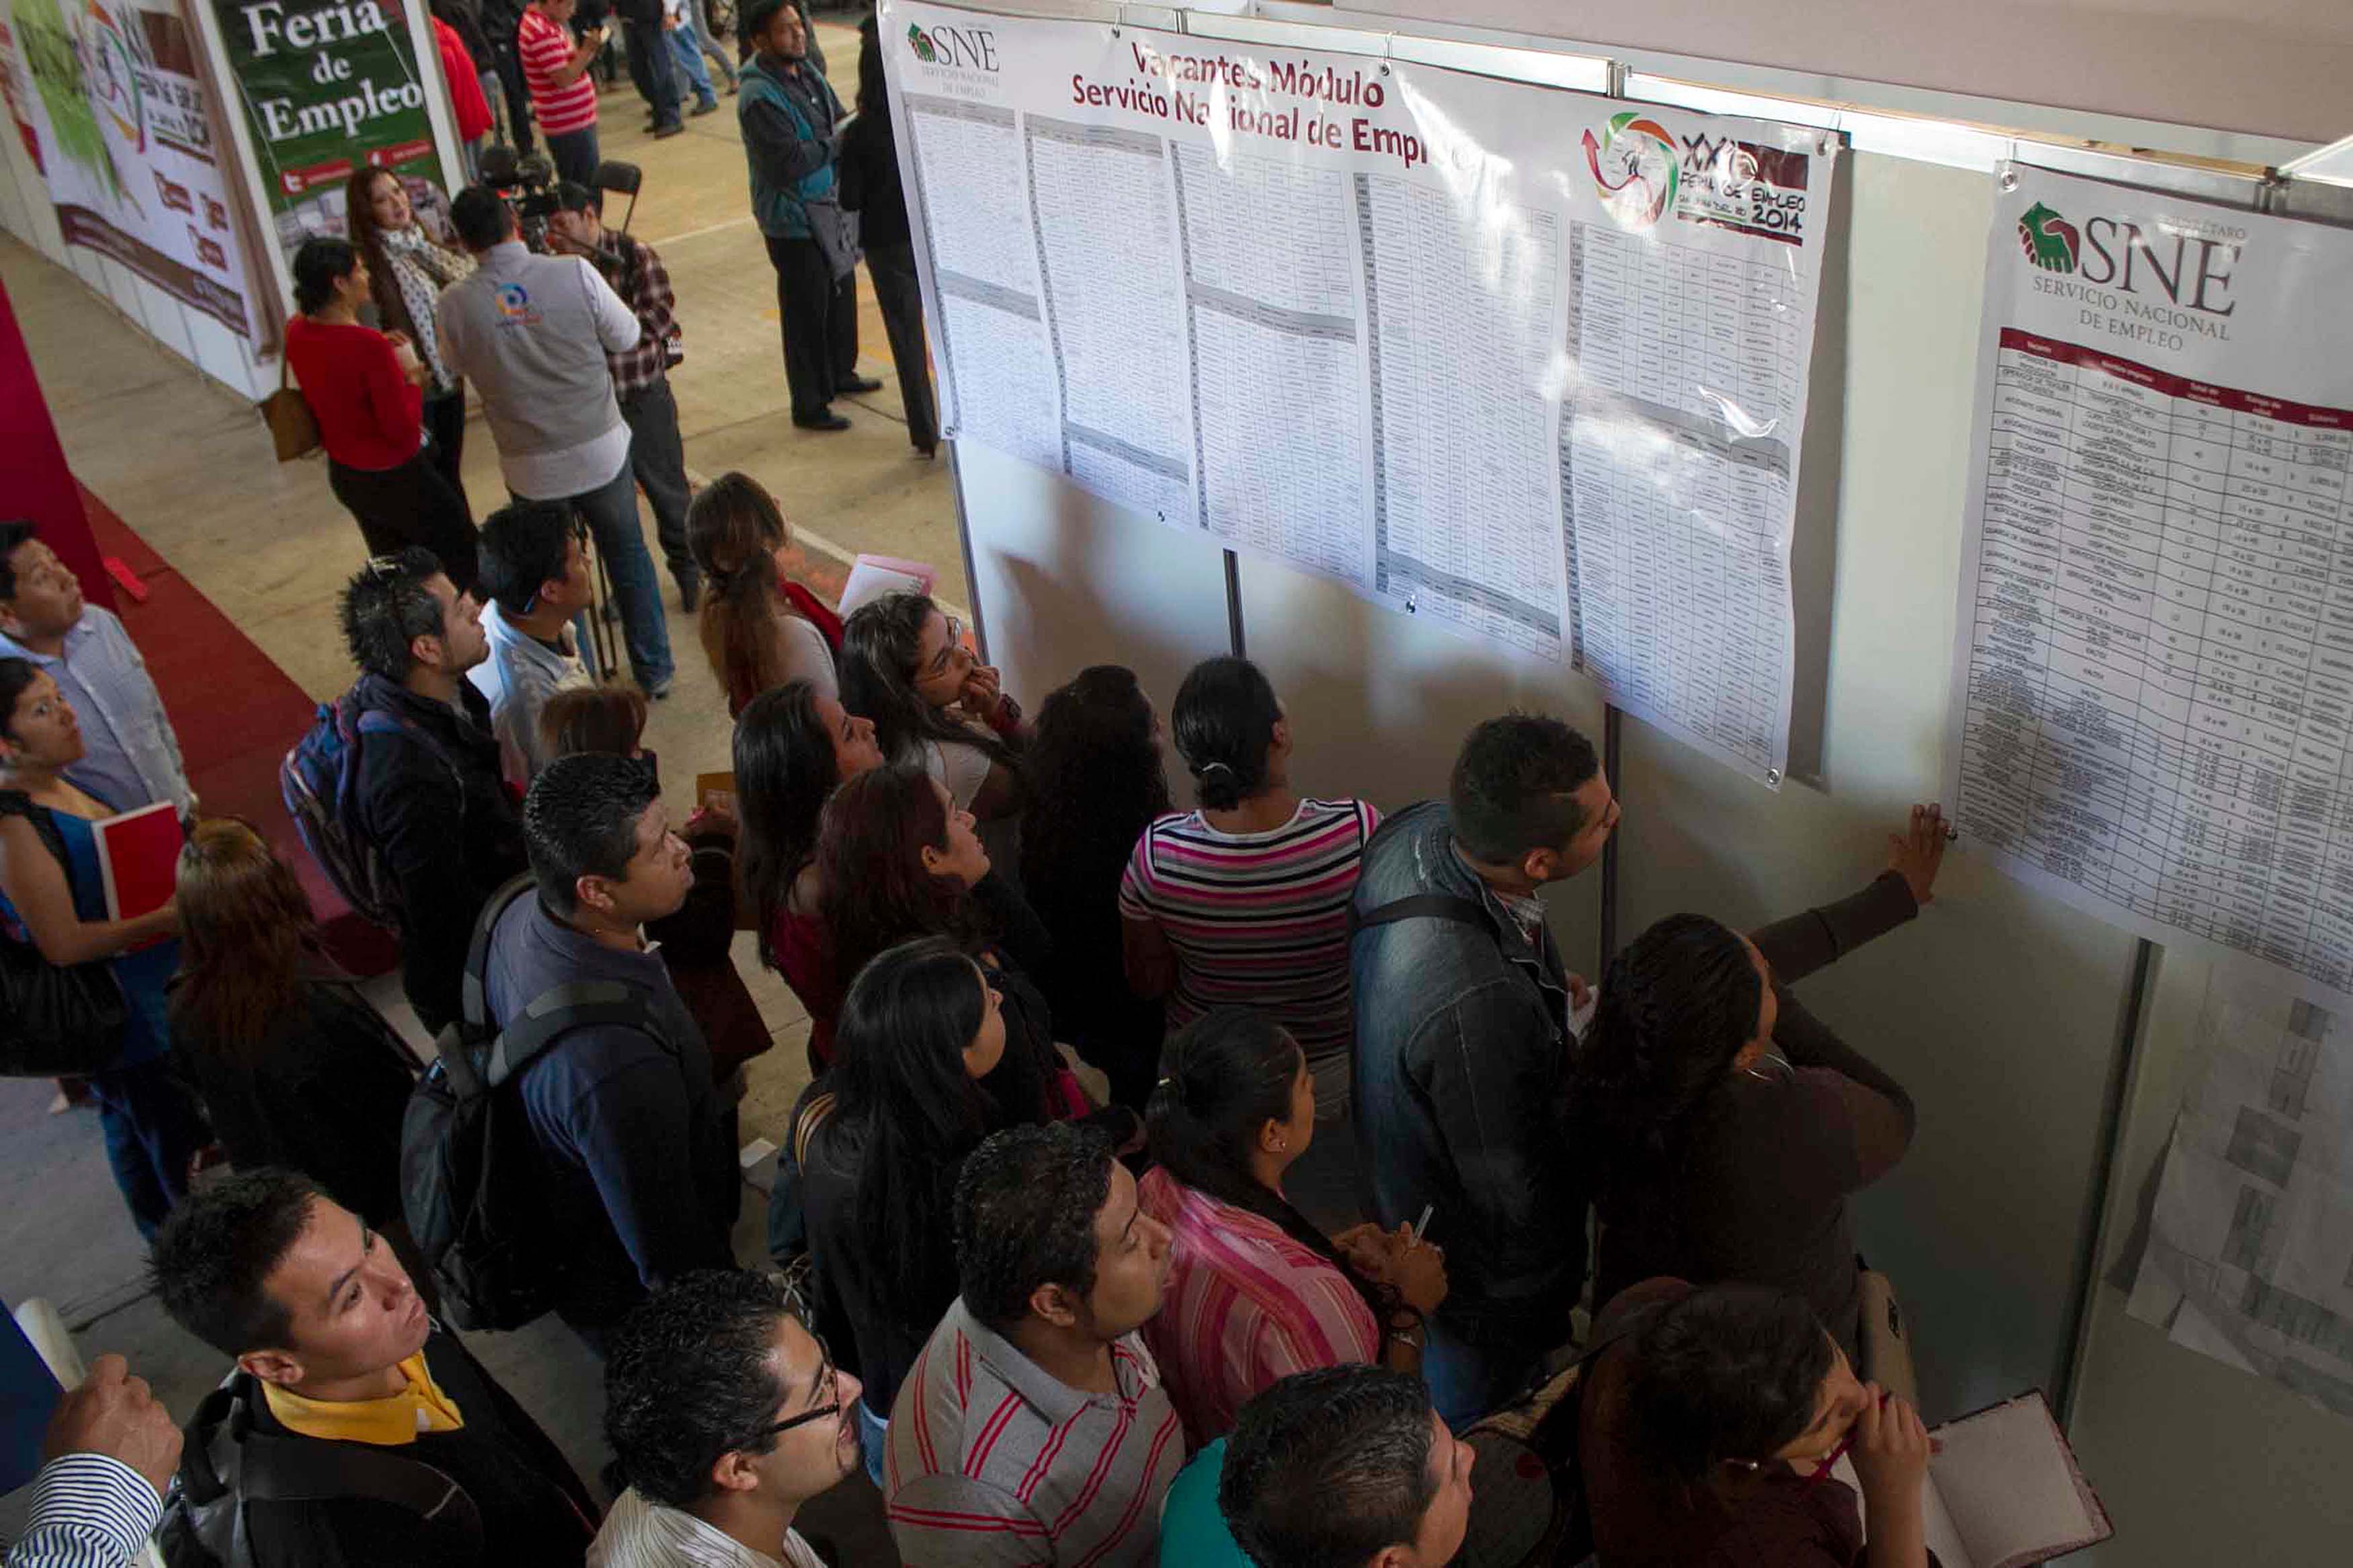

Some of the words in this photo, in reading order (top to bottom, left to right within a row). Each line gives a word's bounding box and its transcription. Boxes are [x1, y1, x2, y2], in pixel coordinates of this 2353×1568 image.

[241, 0, 387, 57] Feria
[932, 26, 1000, 72] SNE
[313, 51, 352, 84] de
[1132, 42, 1261, 89] Vacantes
[1269, 60, 1385, 108] Módulo
[260, 78, 423, 142] Empleo
[1072, 73, 1169, 119] Servicio
[1174, 90, 1299, 140] Naional
[1307, 111, 1342, 149] de
[1751, 204, 1803, 234] 2014
[2081, 216, 2241, 317] SNE
[2033, 276, 2118, 311] SERVICIO
[2124, 299, 2231, 341] NACIONAL
[2079, 309, 2102, 330] DE
[2108, 319, 2184, 352] EMPLEO
